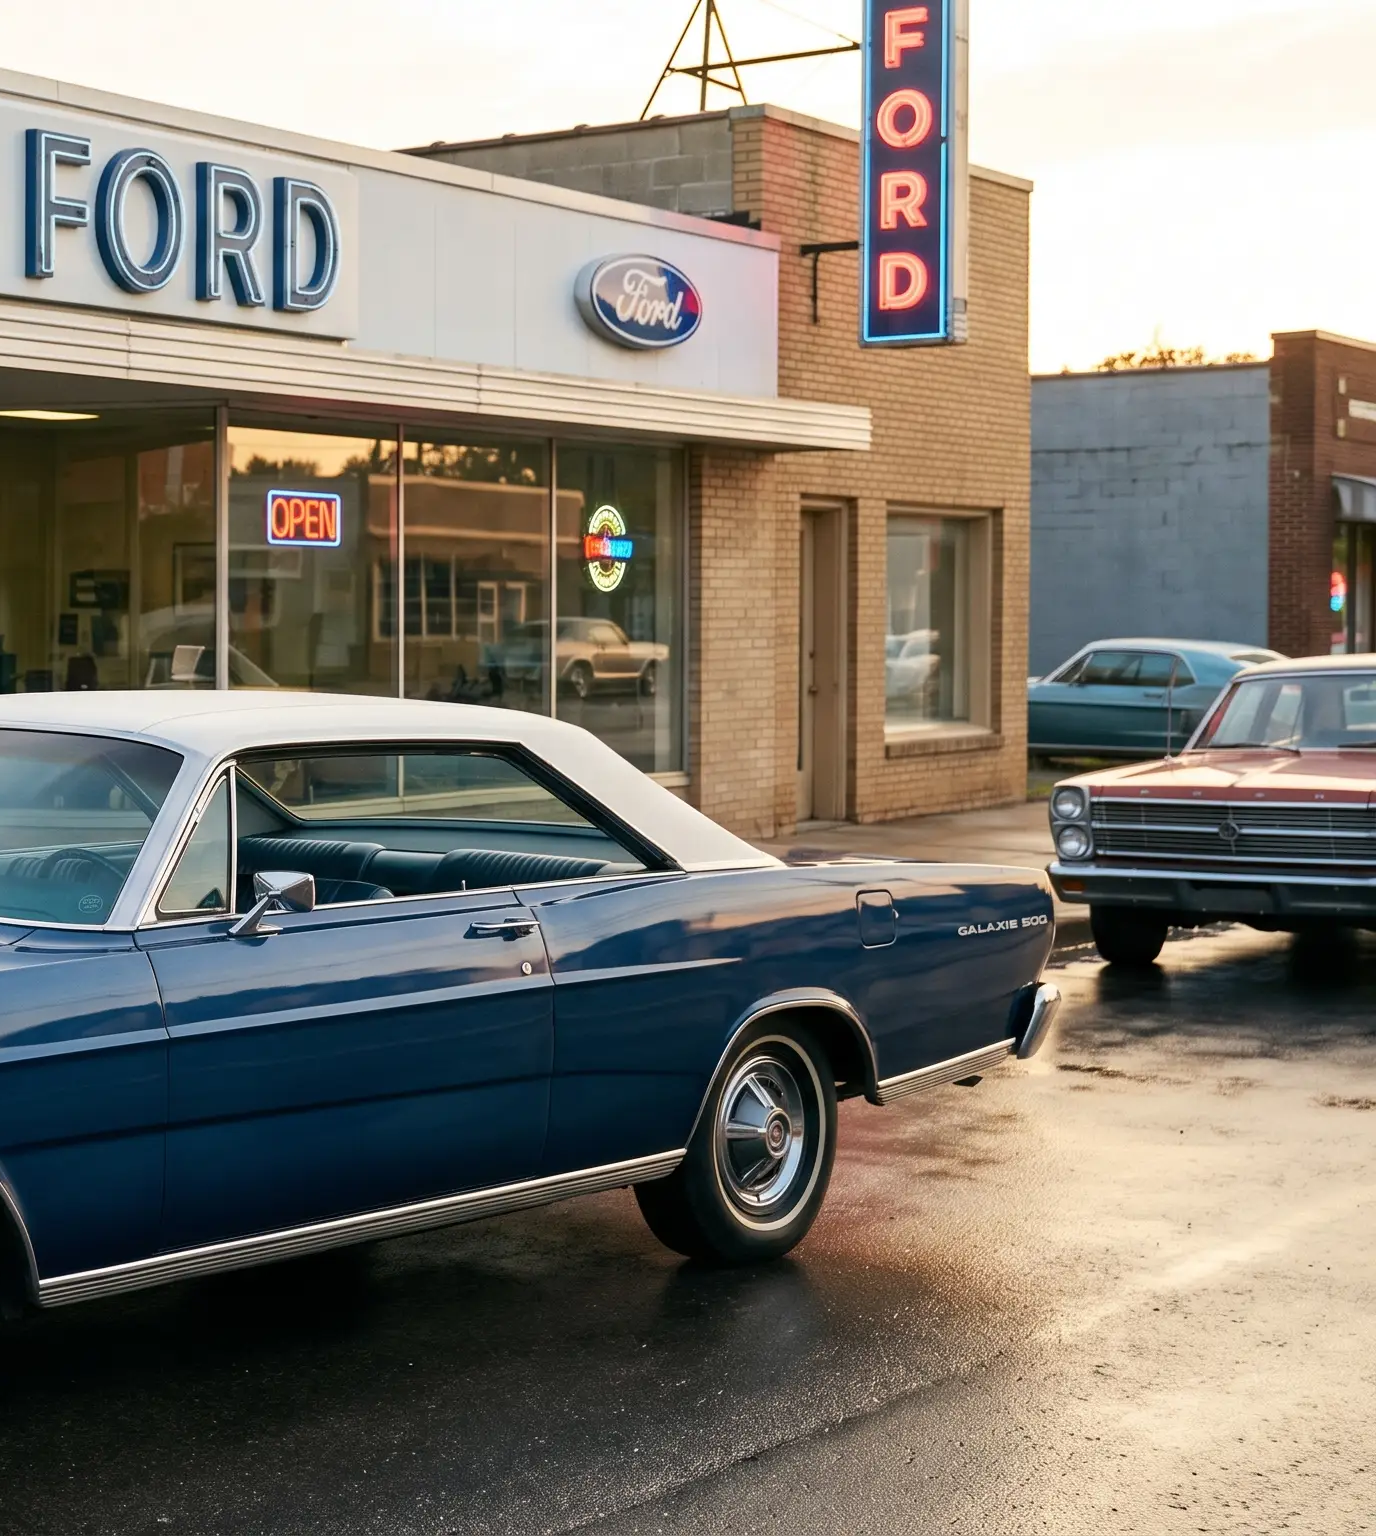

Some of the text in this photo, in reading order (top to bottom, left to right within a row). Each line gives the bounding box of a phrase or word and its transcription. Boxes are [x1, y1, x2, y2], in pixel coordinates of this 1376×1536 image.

[876, 7, 933, 311] FORD
[25, 129, 341, 313] FORD
[616, 268, 684, 330] Ford
[272, 498, 336, 540] OPEN
[958, 914, 1048, 936] GALAXIE 500
